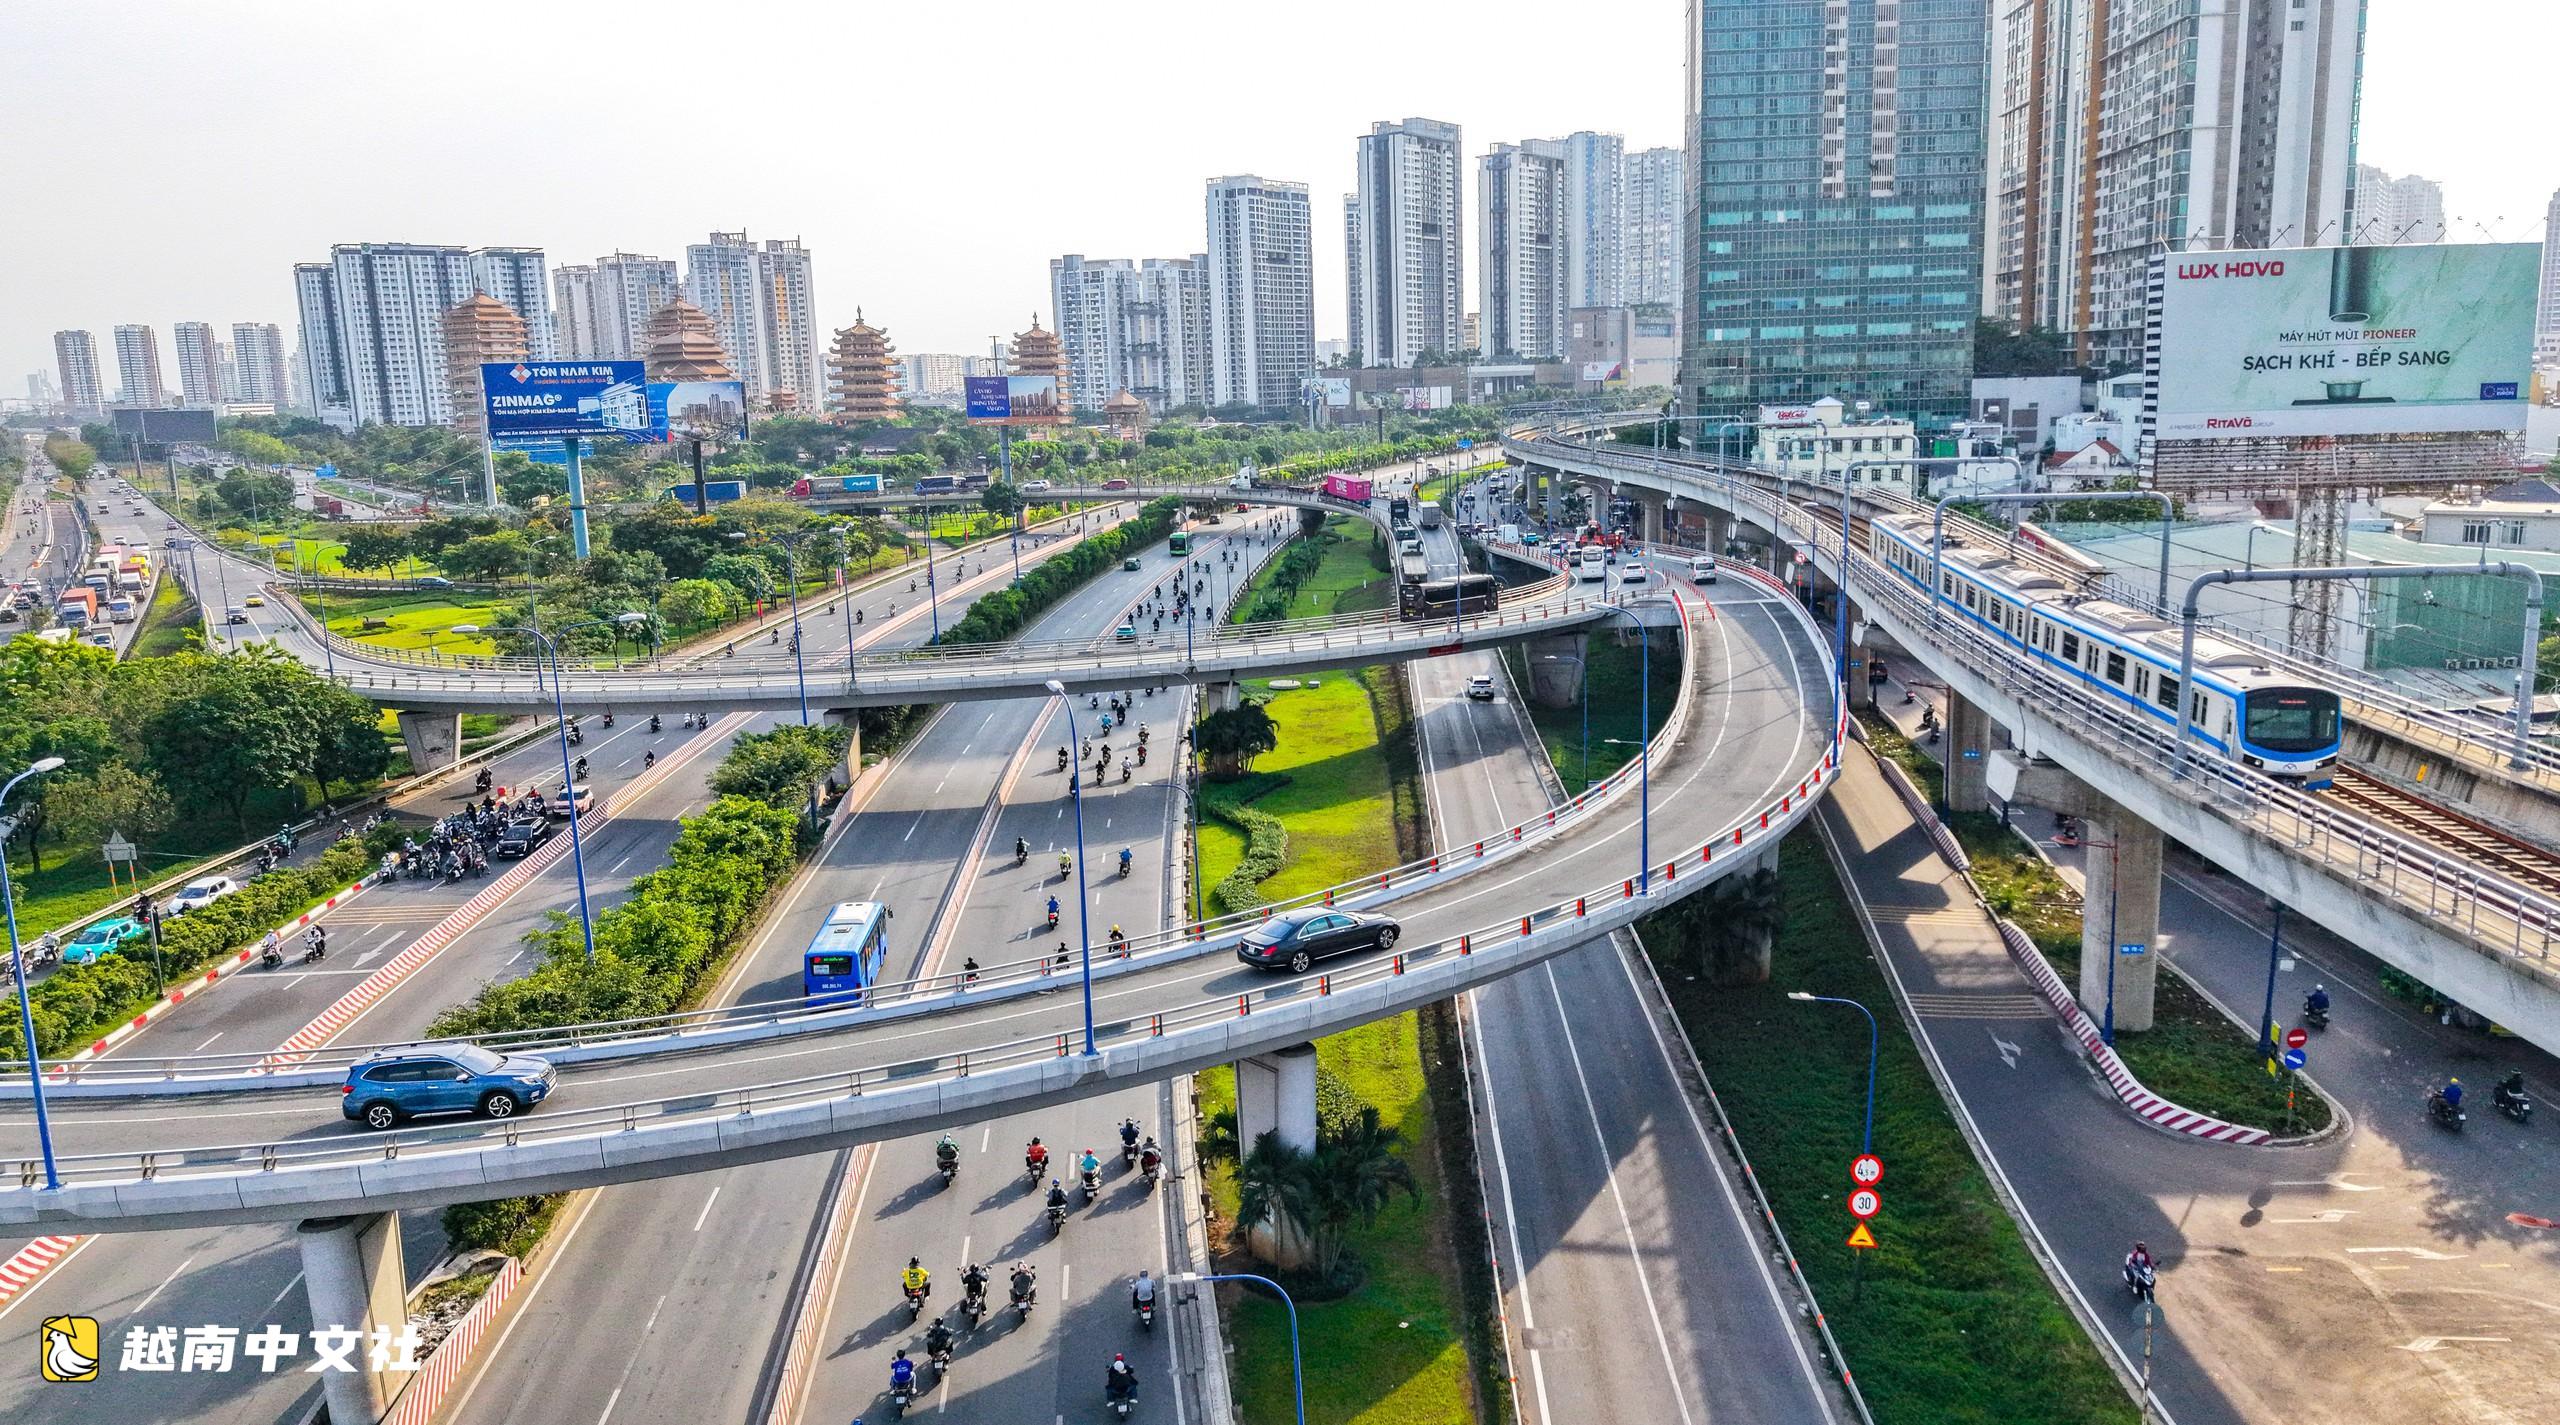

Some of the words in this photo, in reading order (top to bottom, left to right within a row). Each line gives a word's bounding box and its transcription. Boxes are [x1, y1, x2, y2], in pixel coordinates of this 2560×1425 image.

[2178, 263, 2219, 279] LUX
[2225, 261, 2285, 278] HOVO
[2279, 332, 2304, 342] MÁY
[2307, 331, 2331, 341] HÚT
[2335, 329, 2359, 340] MÙI
[2362, 328, 2416, 339] PIONEER
[2243, 355, 2292, 374] SẠCH
[2299, 350, 2335, 369] KHÍ
[2356, 346, 2391, 367] BẾP
[2398, 350, 2450, 366] SANG
[532, 365, 557, 377] TÔN
[561, 366, 589, 377] NAM
[591, 366, 613, 376] KIM
[1336, 479, 1347, 492] ONE
[1859, 1197, 1870, 1209] 30
